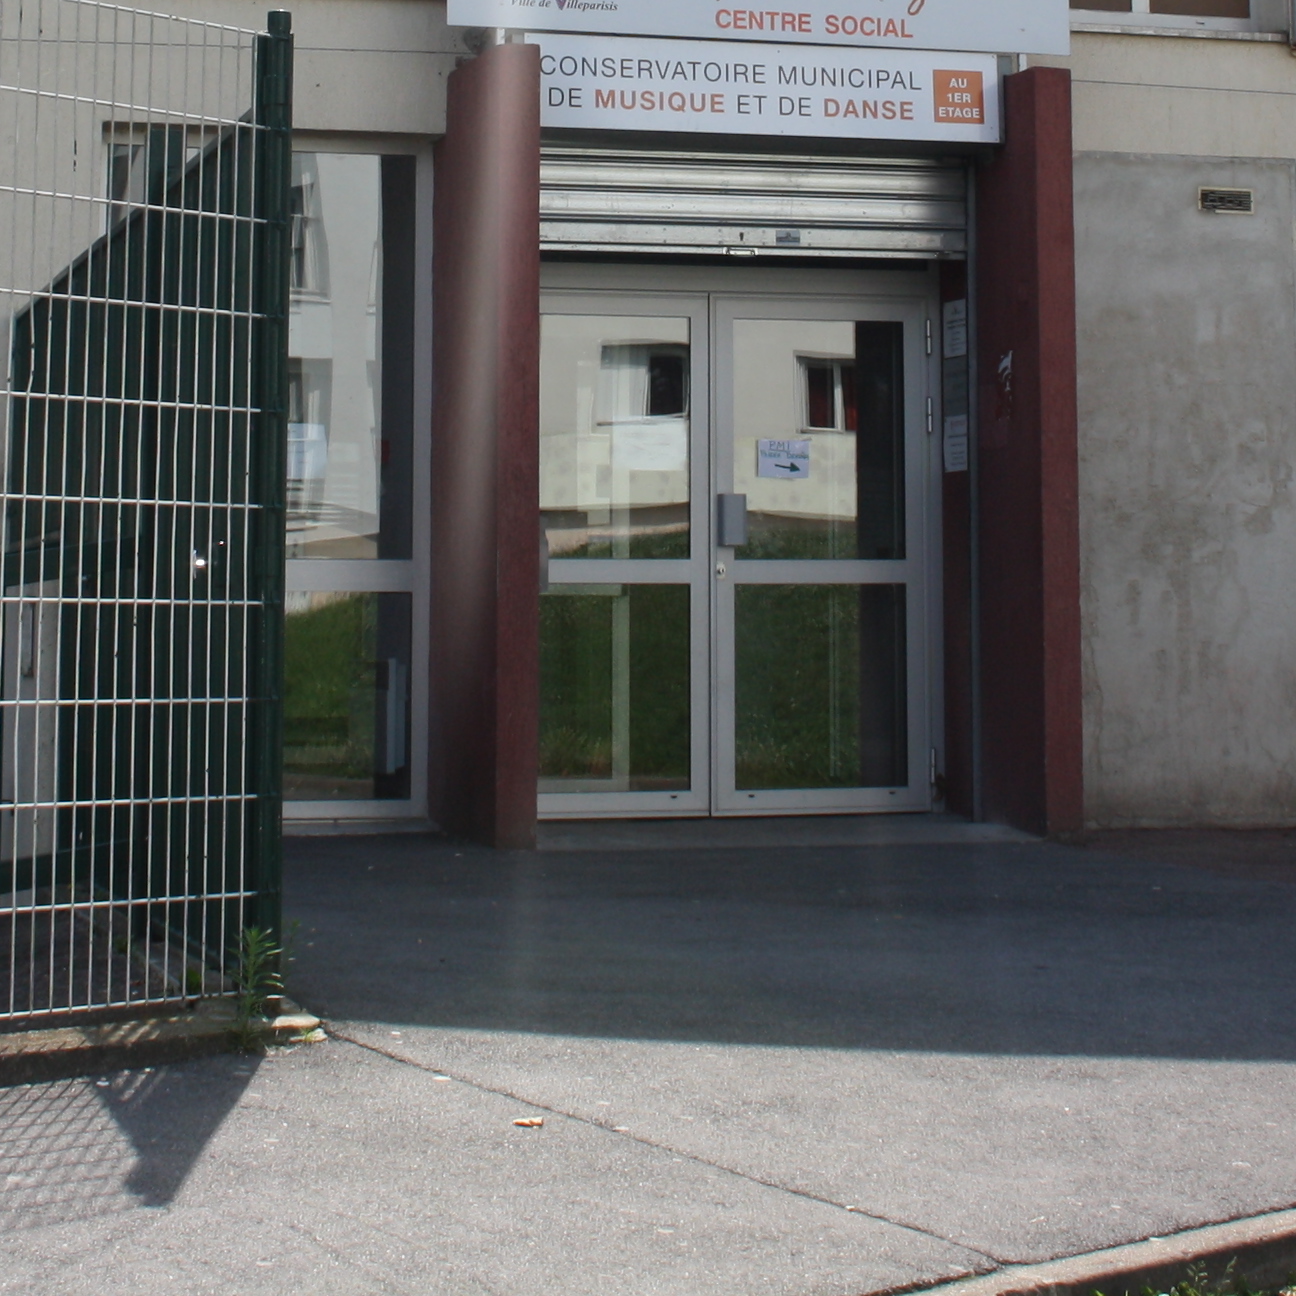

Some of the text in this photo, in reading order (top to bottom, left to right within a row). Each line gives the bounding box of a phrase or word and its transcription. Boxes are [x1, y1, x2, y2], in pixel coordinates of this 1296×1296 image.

[714, 9, 914, 39] CENTRE SOCIAL
[540, 54, 922, 91] CONSERVATOIRE MUNICIPAL
[948, 77, 968, 89] AU
[548, 87, 915, 120] DE MUSIQUE ET DE DANSE
[946, 92, 972, 104] 1ER
[938, 107, 981, 119] ETAGE
[769, 440, 790, 451] PMI
